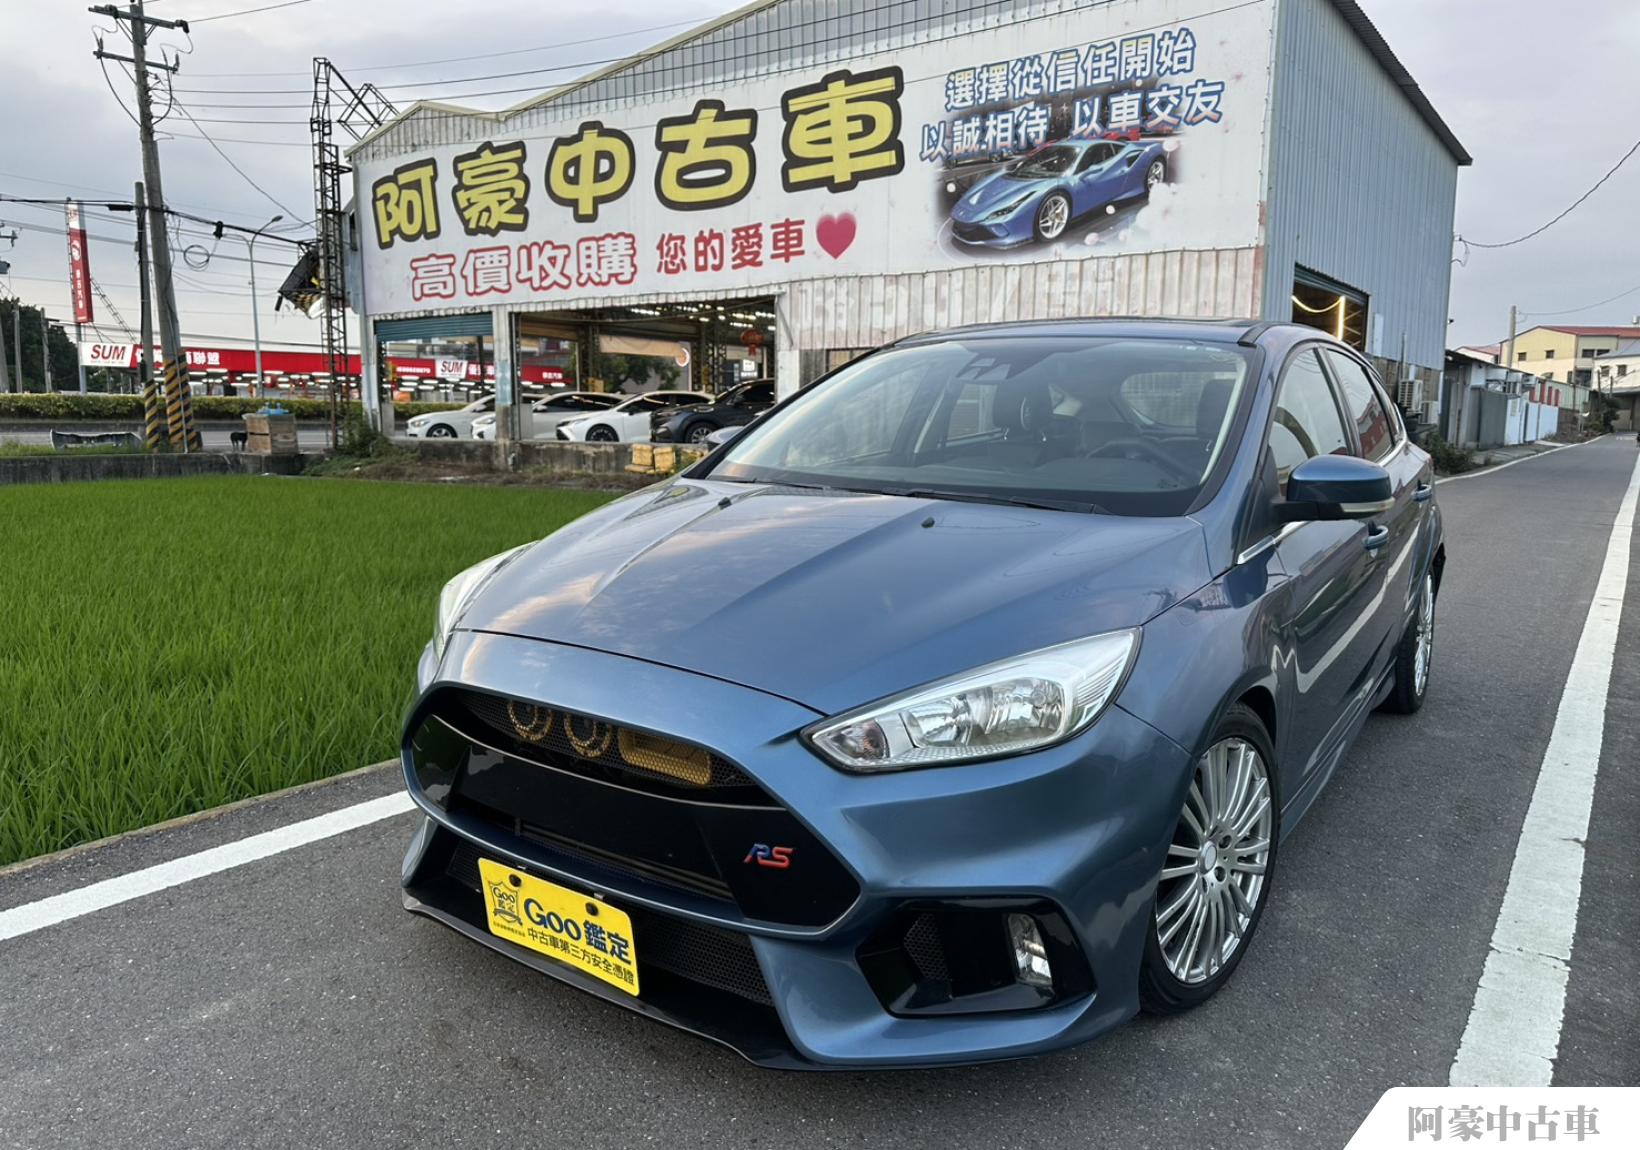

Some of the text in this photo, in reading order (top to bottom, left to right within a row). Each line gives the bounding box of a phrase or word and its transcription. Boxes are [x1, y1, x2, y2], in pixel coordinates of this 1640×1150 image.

[945, 27, 1197, 112] 選擇從信任開始
[919, 78, 1225, 162] 以誠相待 以車交友
[372, 66, 904, 250] 阿豪中古車
[410, 217, 806, 301] 高價收購 您的愛車
[90, 344, 127, 361] SUM
[440, 360, 464, 374] SUM
[743, 843, 793, 868] RS
[583, 918, 632, 966] 鑑定
